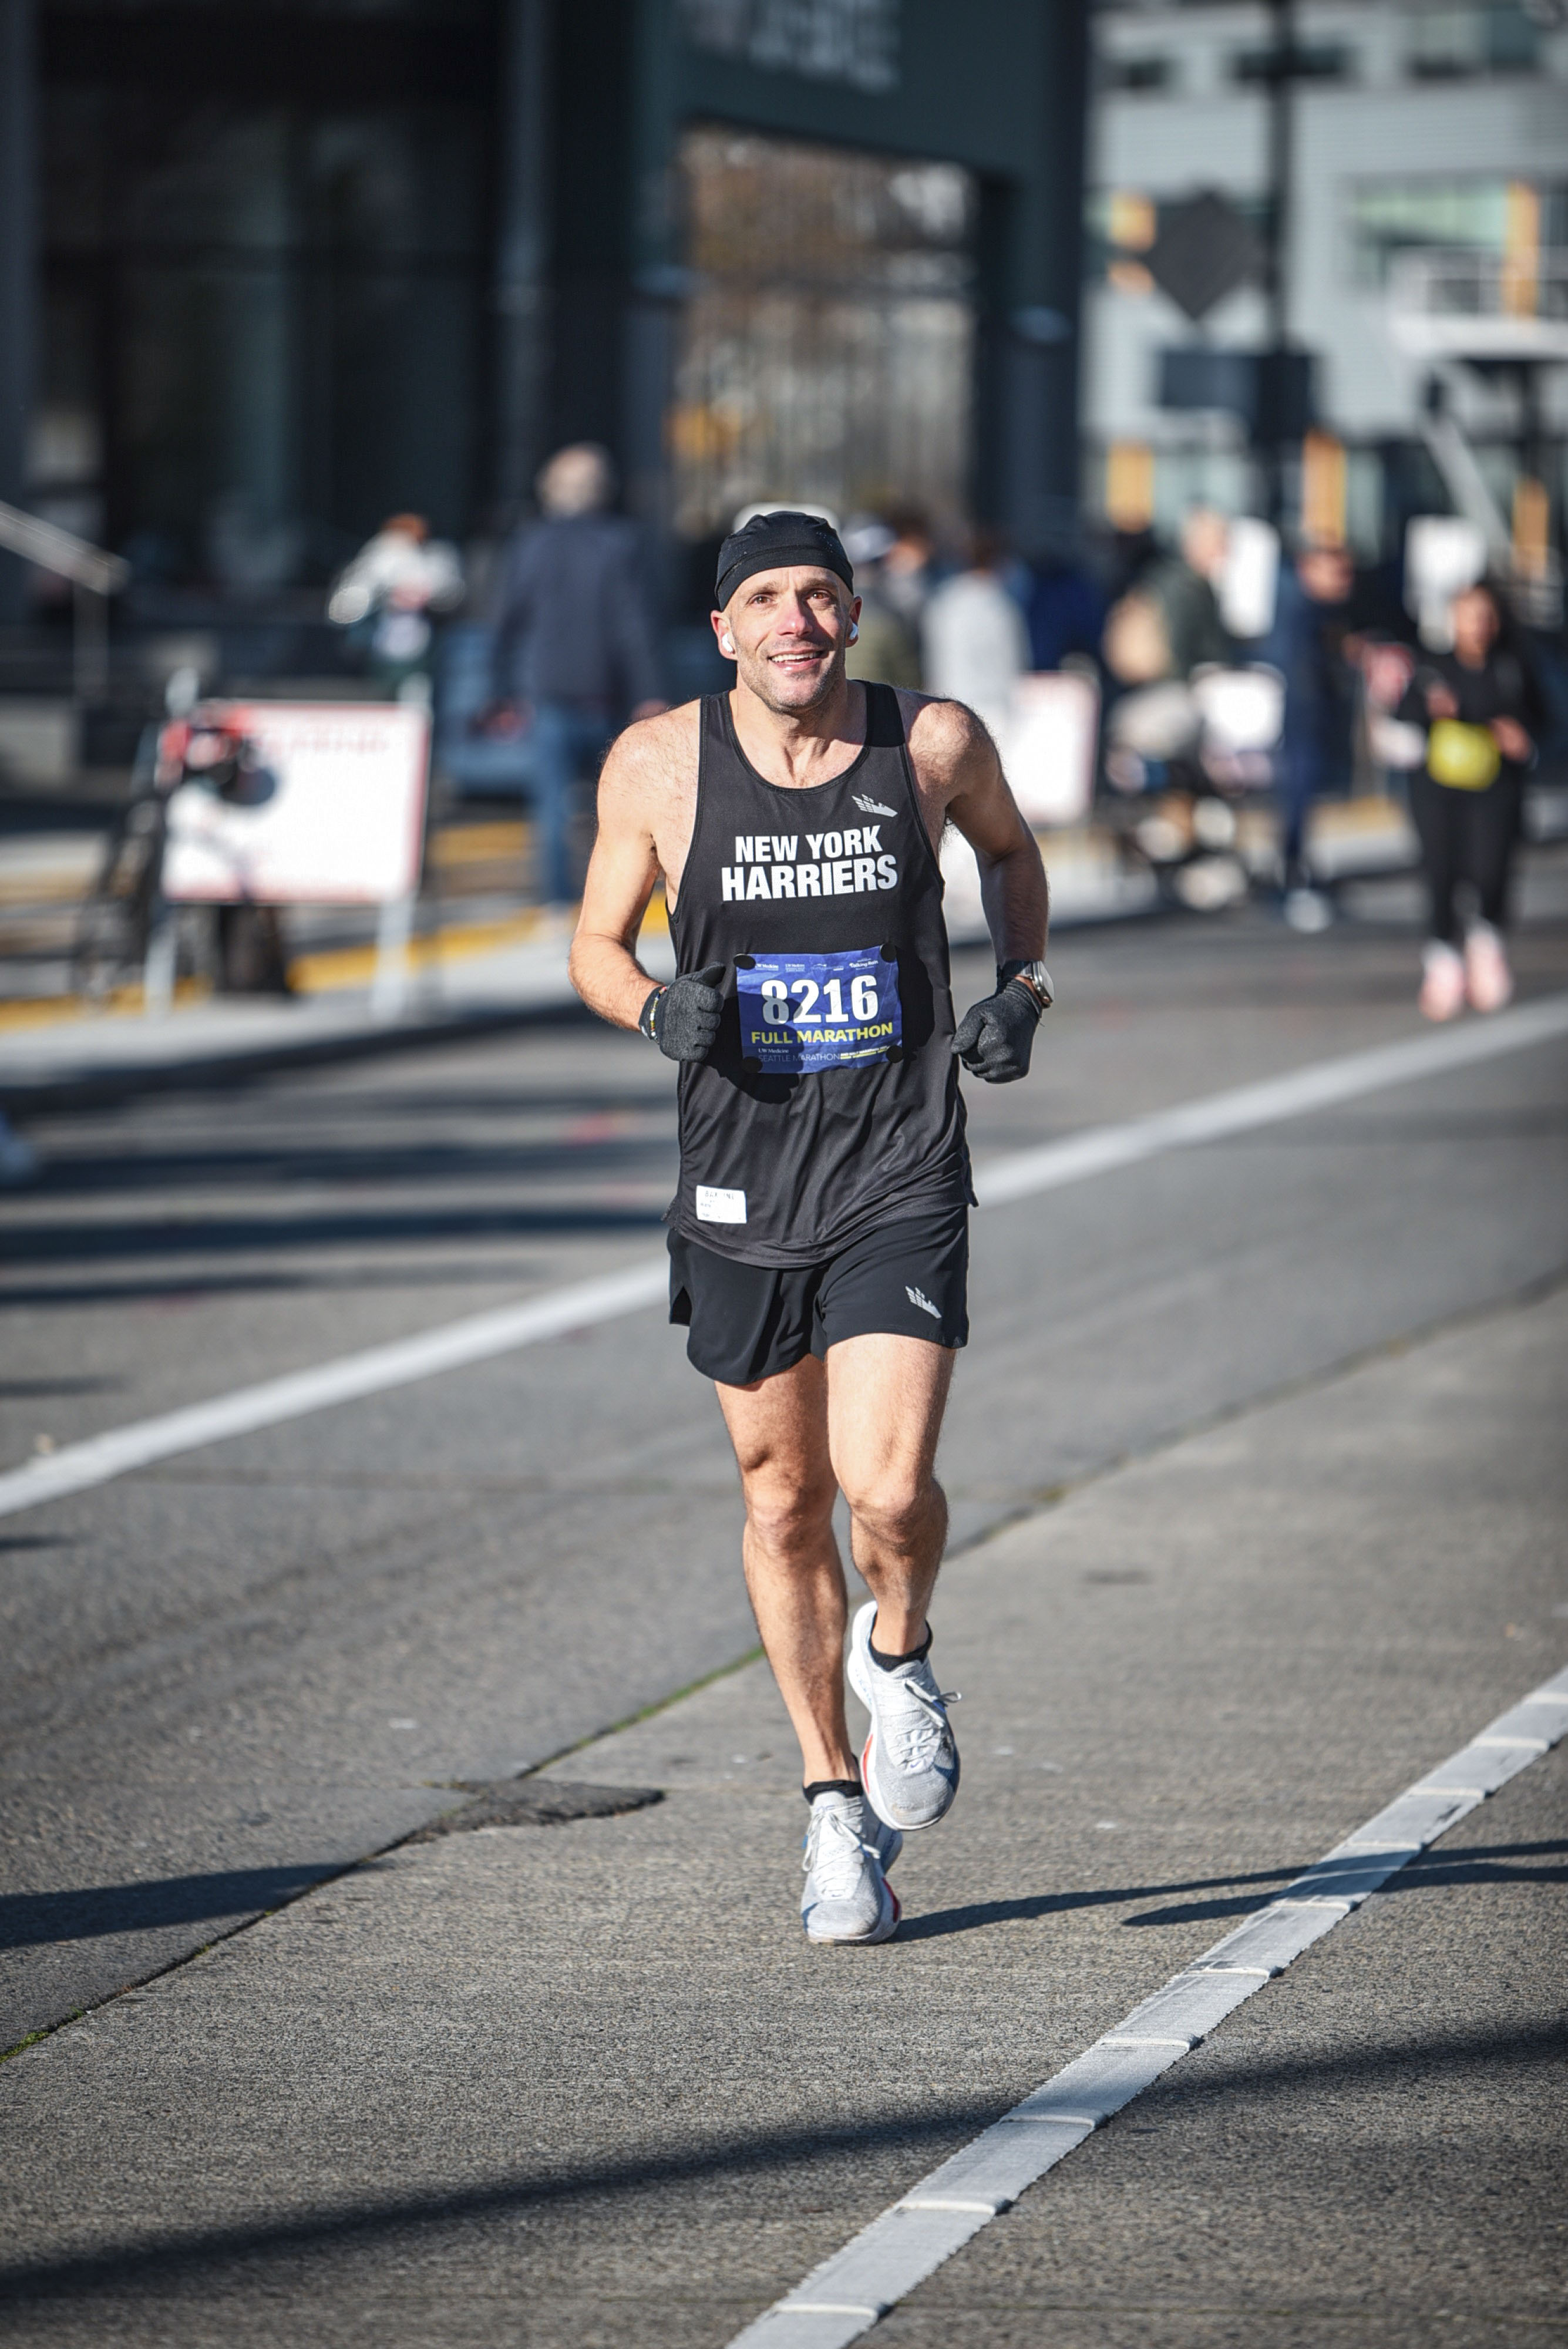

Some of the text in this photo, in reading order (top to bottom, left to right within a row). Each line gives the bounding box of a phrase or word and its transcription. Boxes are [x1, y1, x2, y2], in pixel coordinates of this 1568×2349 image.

[735, 825, 883, 863] NEW YORK
[721, 854, 898, 901] HARRIERS
[761, 975, 879, 1025] 8216
[751, 1022, 893, 1044] FULL MARATHON
[793, 1053, 840, 1062] MARATHON
